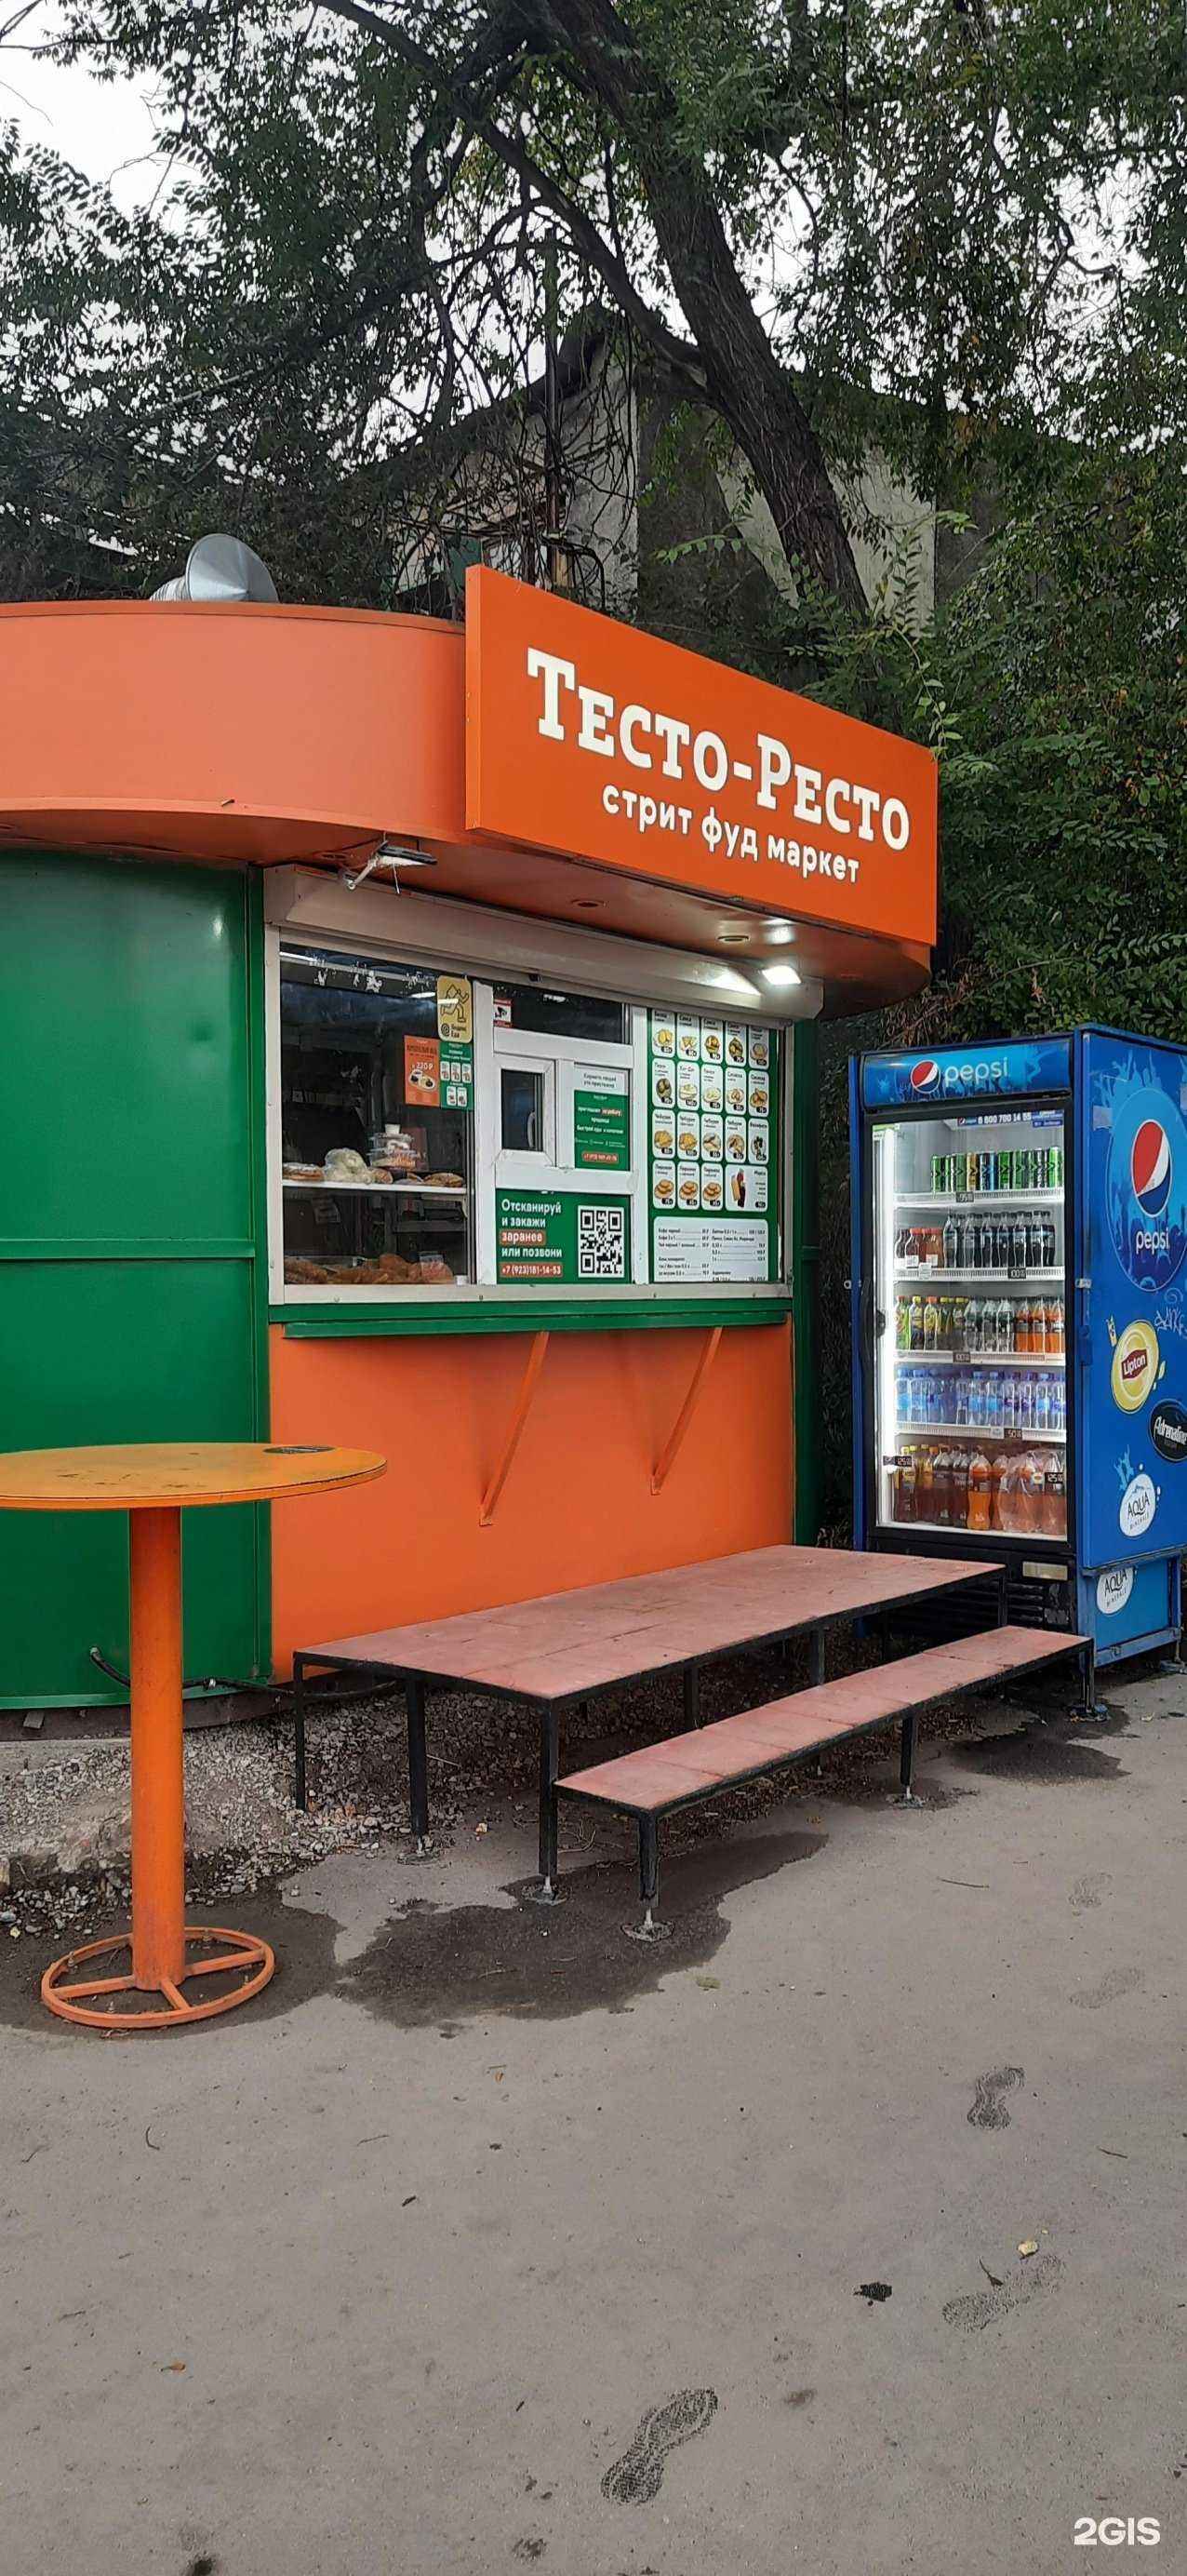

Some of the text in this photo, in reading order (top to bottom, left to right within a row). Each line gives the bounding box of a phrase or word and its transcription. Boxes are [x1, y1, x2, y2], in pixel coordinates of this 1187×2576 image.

[603, 785, 860, 883] стрит фуд маркет
[944, 1056, 1008, 1087] pepsi
[501, 1199, 562, 1216] Отсканируй
[502, 1217, 546, 1228] и закажи
[502, 1232, 543, 1244] заранее
[1136, 1227, 1169, 1255] pepsi
[502, 1247, 562, 1257] или позвони
[1124, 1354, 1146, 1375] Lipton
[1127, 1491, 1151, 1519] AQUA
[1104, 1568, 1128, 1597] AQUA
